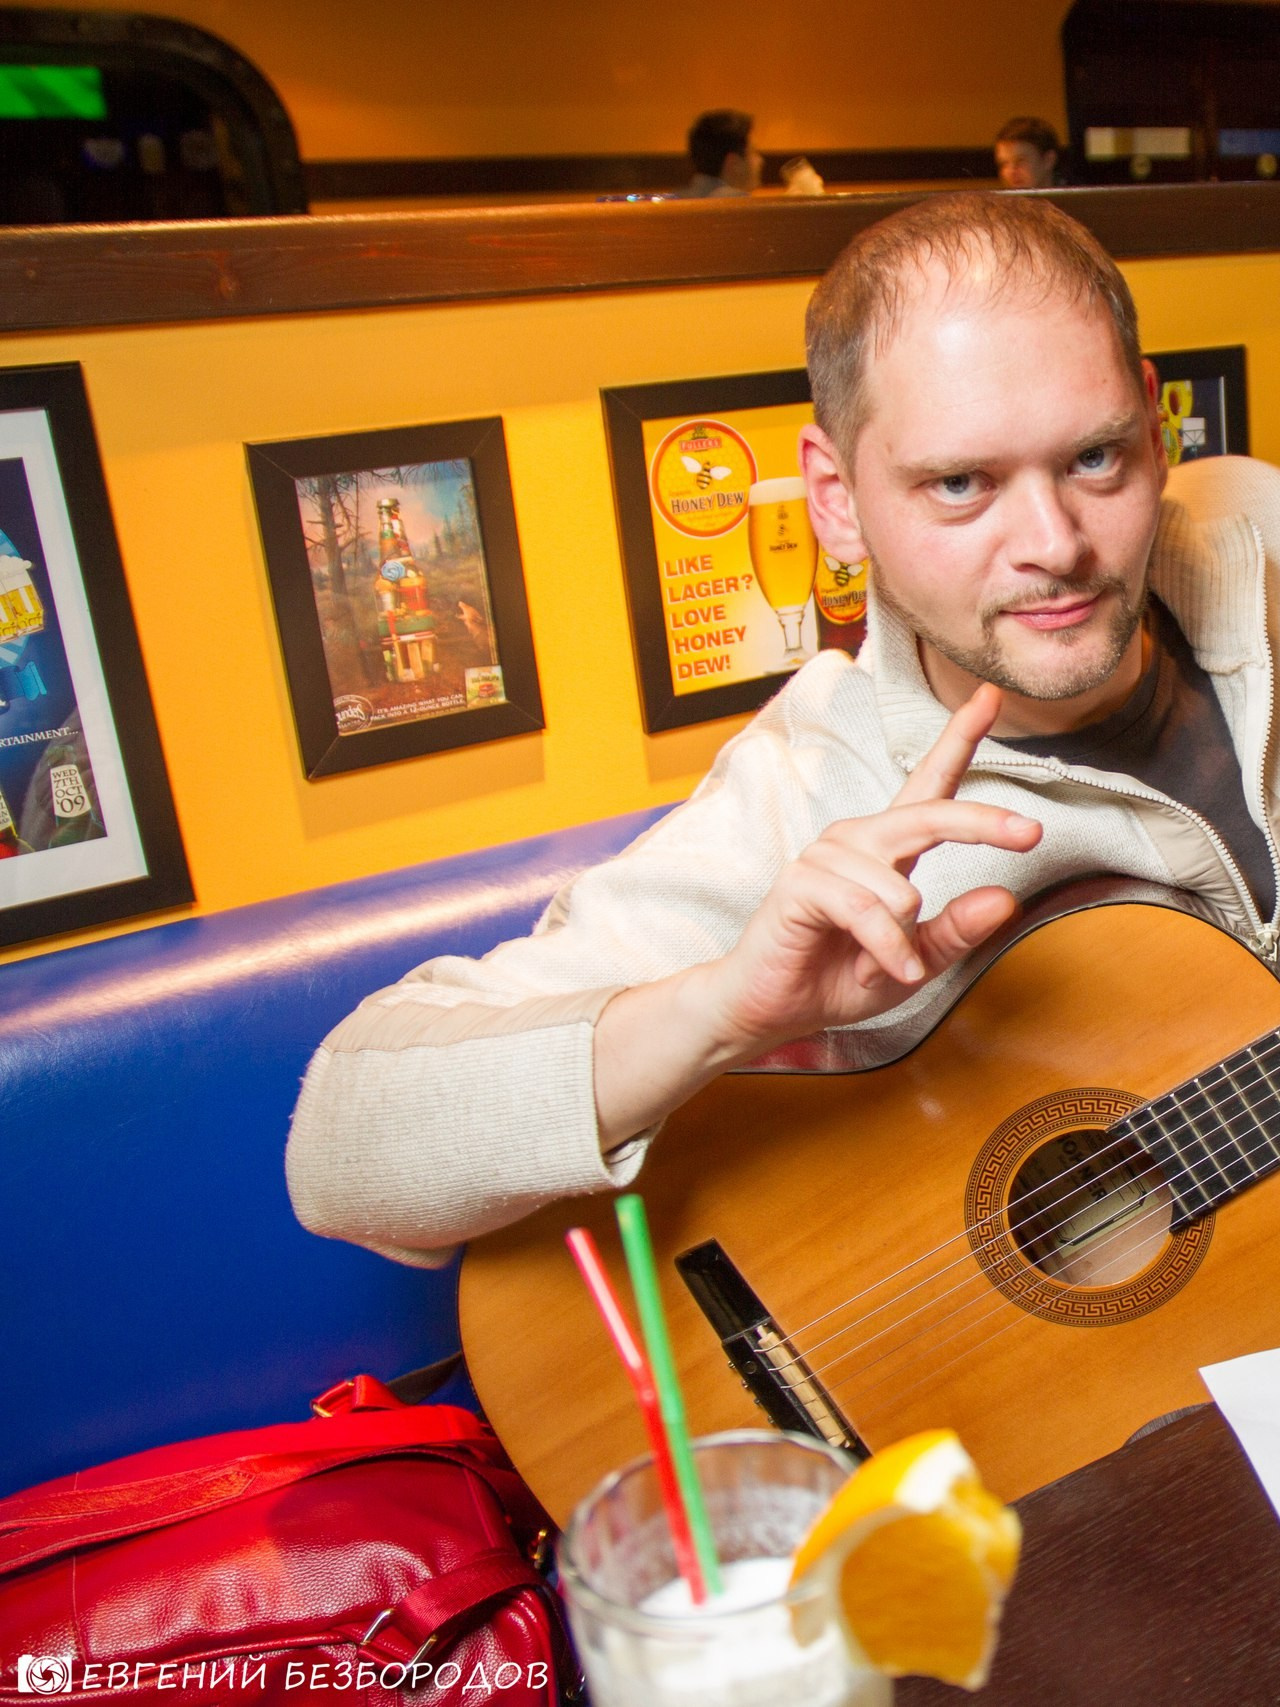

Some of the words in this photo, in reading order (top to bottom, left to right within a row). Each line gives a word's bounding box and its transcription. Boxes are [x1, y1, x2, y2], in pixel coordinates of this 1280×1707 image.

[671, 494, 714, 514] HONEY
[717, 491, 745, 509] DEW
[665, 554, 713, 578] LIKE
[668, 574, 754, 604] LAGER?
[671, 604, 727, 630] LOVE
[674, 625, 747, 655] HONEY
[677, 654, 731, 681] DEW!
[390, 702, 418, 713] AMAZING
[52, 768, 77, 779] WED
[54, 777, 80, 789] 7TH
[55, 785, 82, 798] OCT
[57, 795, 85, 813] '09
